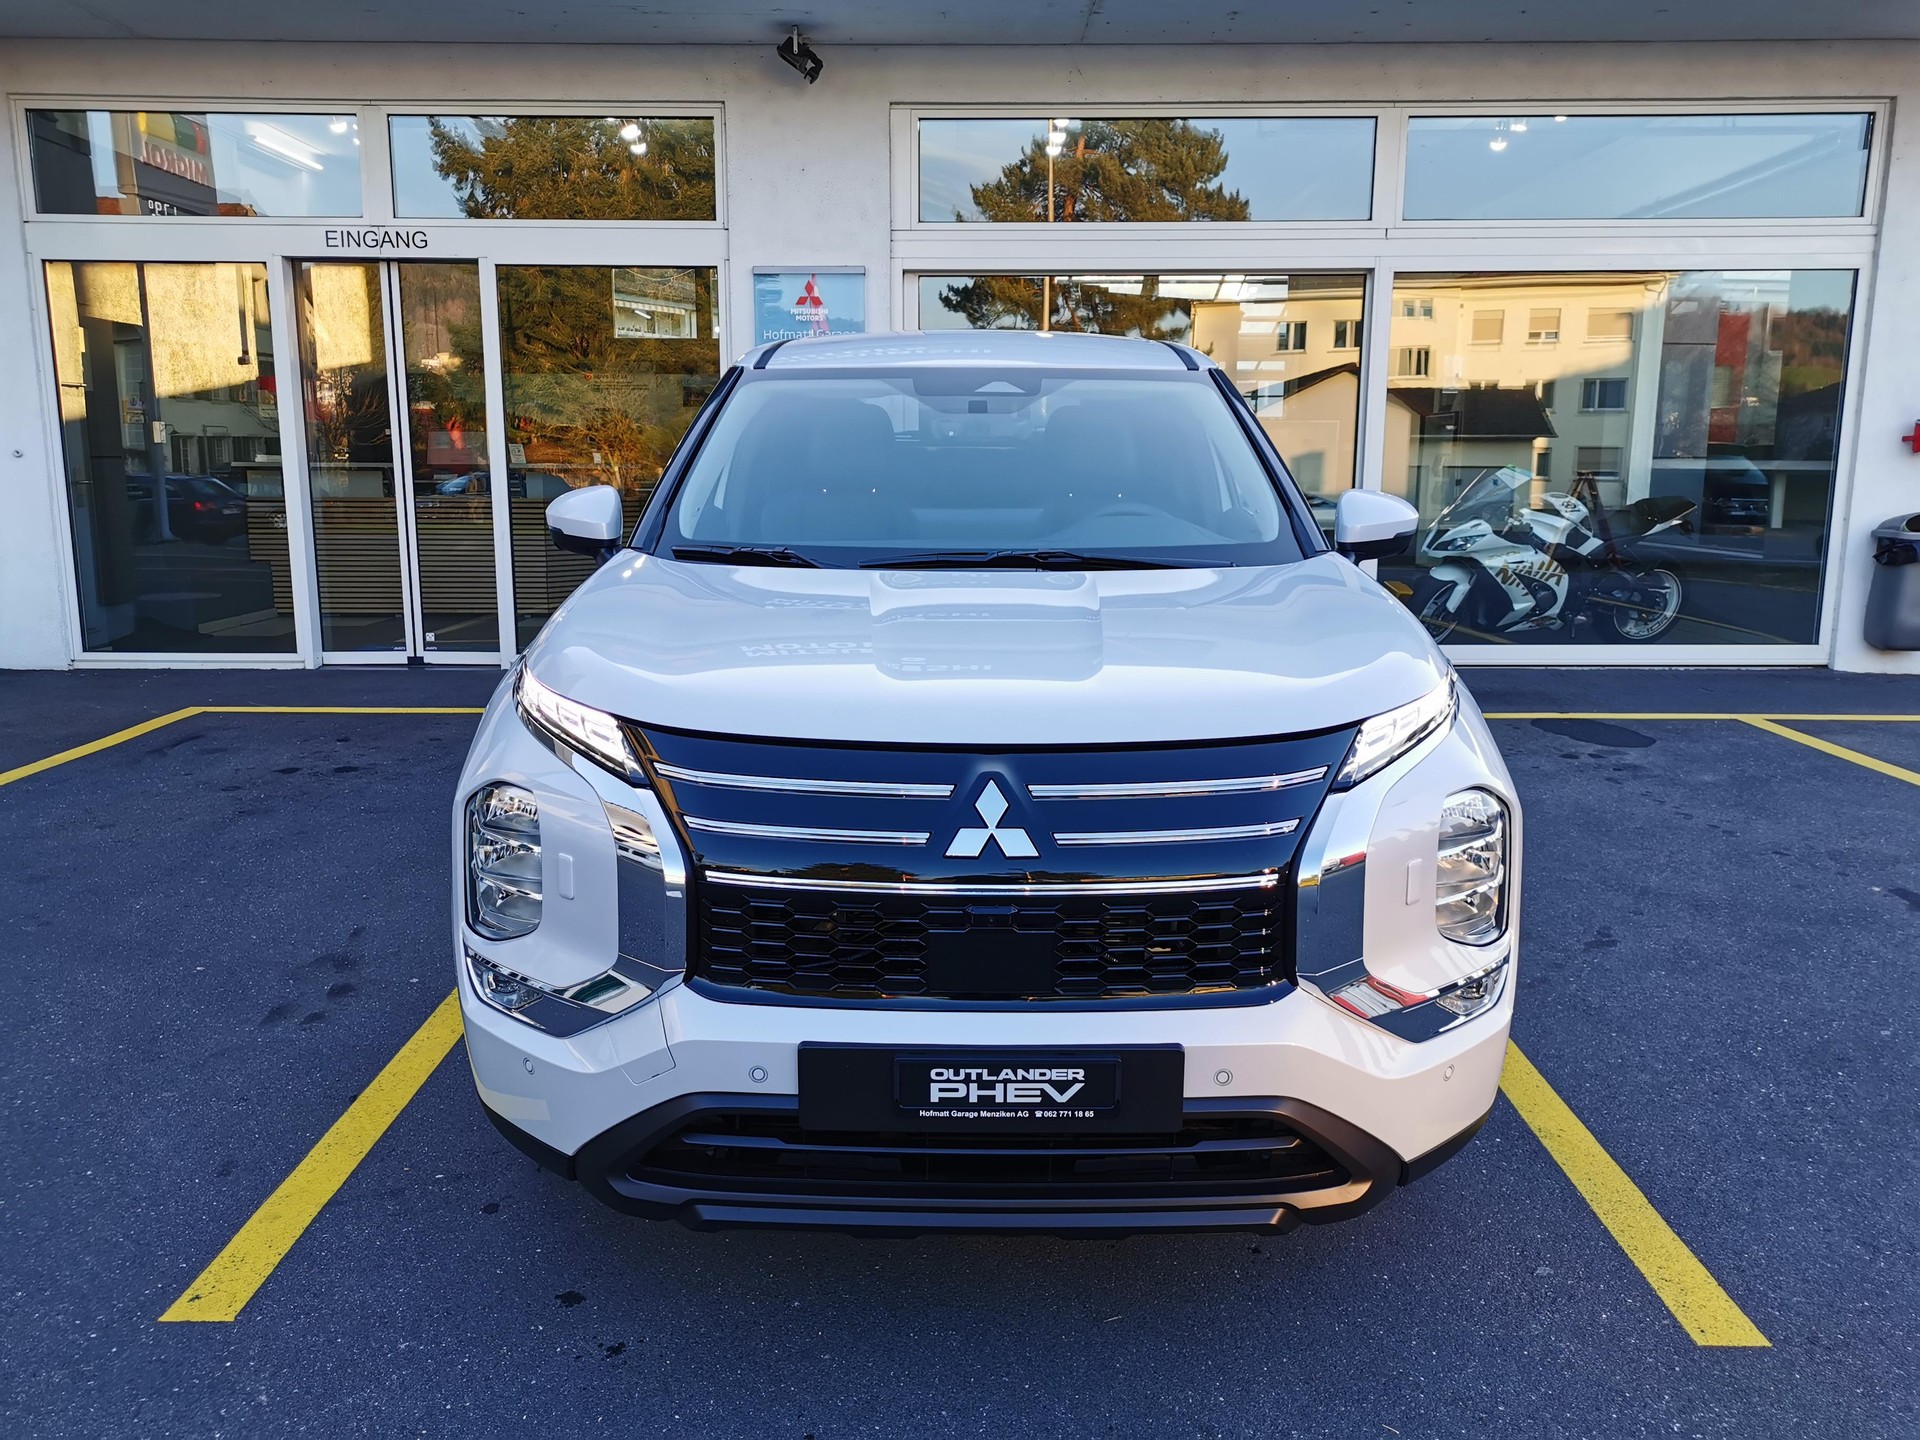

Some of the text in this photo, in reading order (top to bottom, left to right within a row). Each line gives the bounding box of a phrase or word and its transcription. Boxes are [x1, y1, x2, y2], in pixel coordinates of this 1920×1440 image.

[325, 230, 429, 249] EINGANG
[790, 307, 829, 315] MITSUBISHI
[930, 1068, 1086, 1081] OUTLANDER
[930, 1082, 1085, 1103] PHEV
[919, 1109, 1095, 1119] Hofmatt Garage Menziken AG 062 771 18 65
